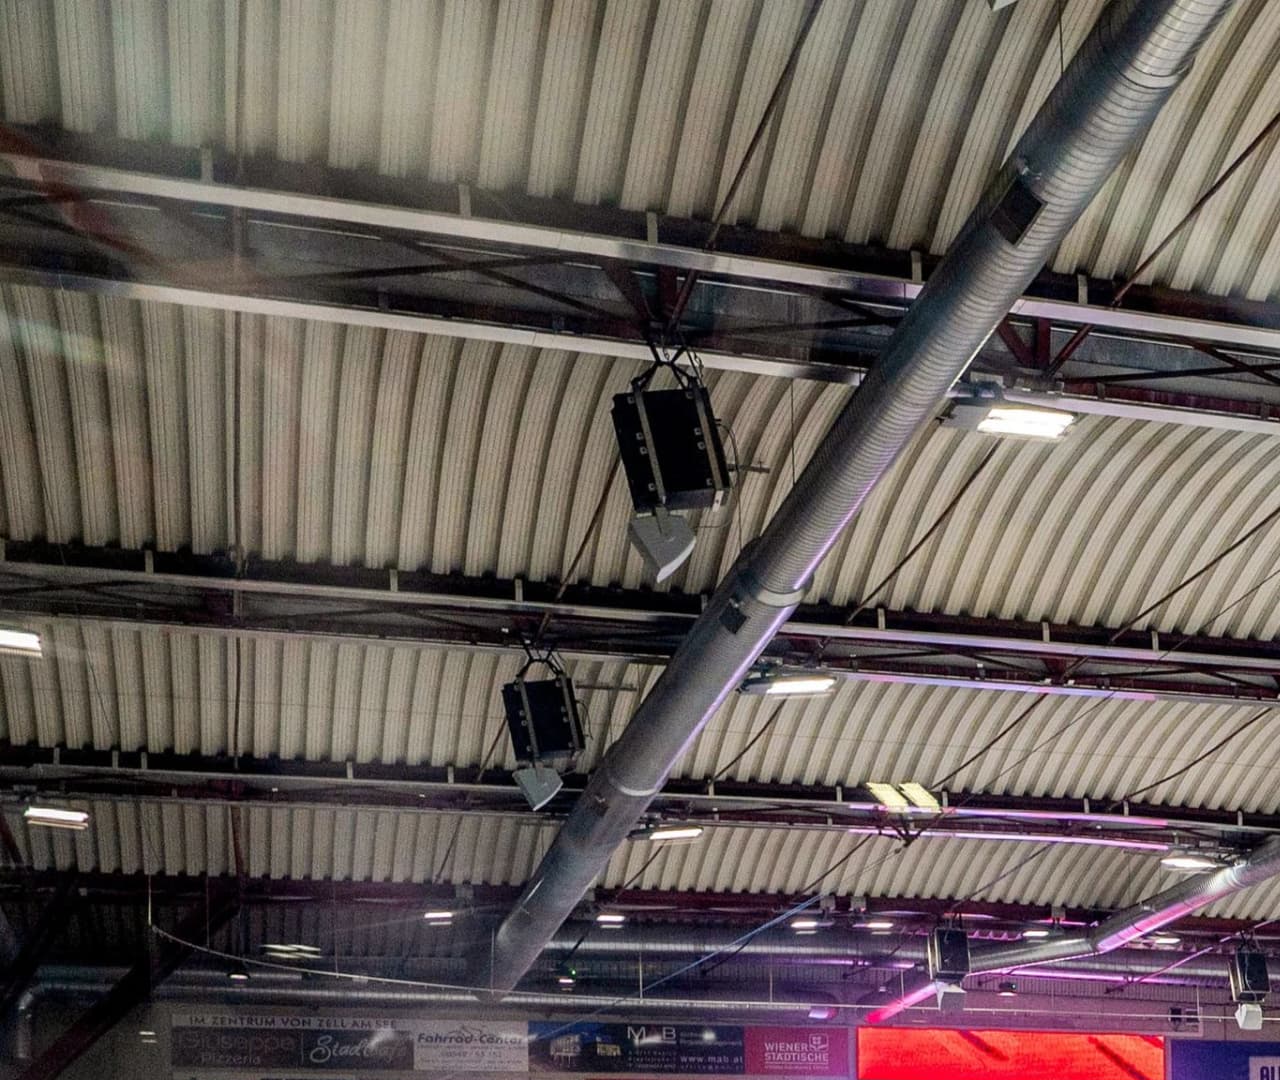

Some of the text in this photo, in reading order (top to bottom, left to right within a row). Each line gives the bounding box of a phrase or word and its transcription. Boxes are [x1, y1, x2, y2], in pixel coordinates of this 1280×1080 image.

[211, 1017, 275, 1027] ZENTRUM
[280, 1018, 312, 1028] VON
[317, 1019, 348, 1028] ZELL
[351, 1019, 372, 1028] AM
[764, 1042, 808, 1052] WIENER
[201, 1052, 262, 1065] Pizzeria
[764, 1051, 829, 1063] STÄDTISCHE
